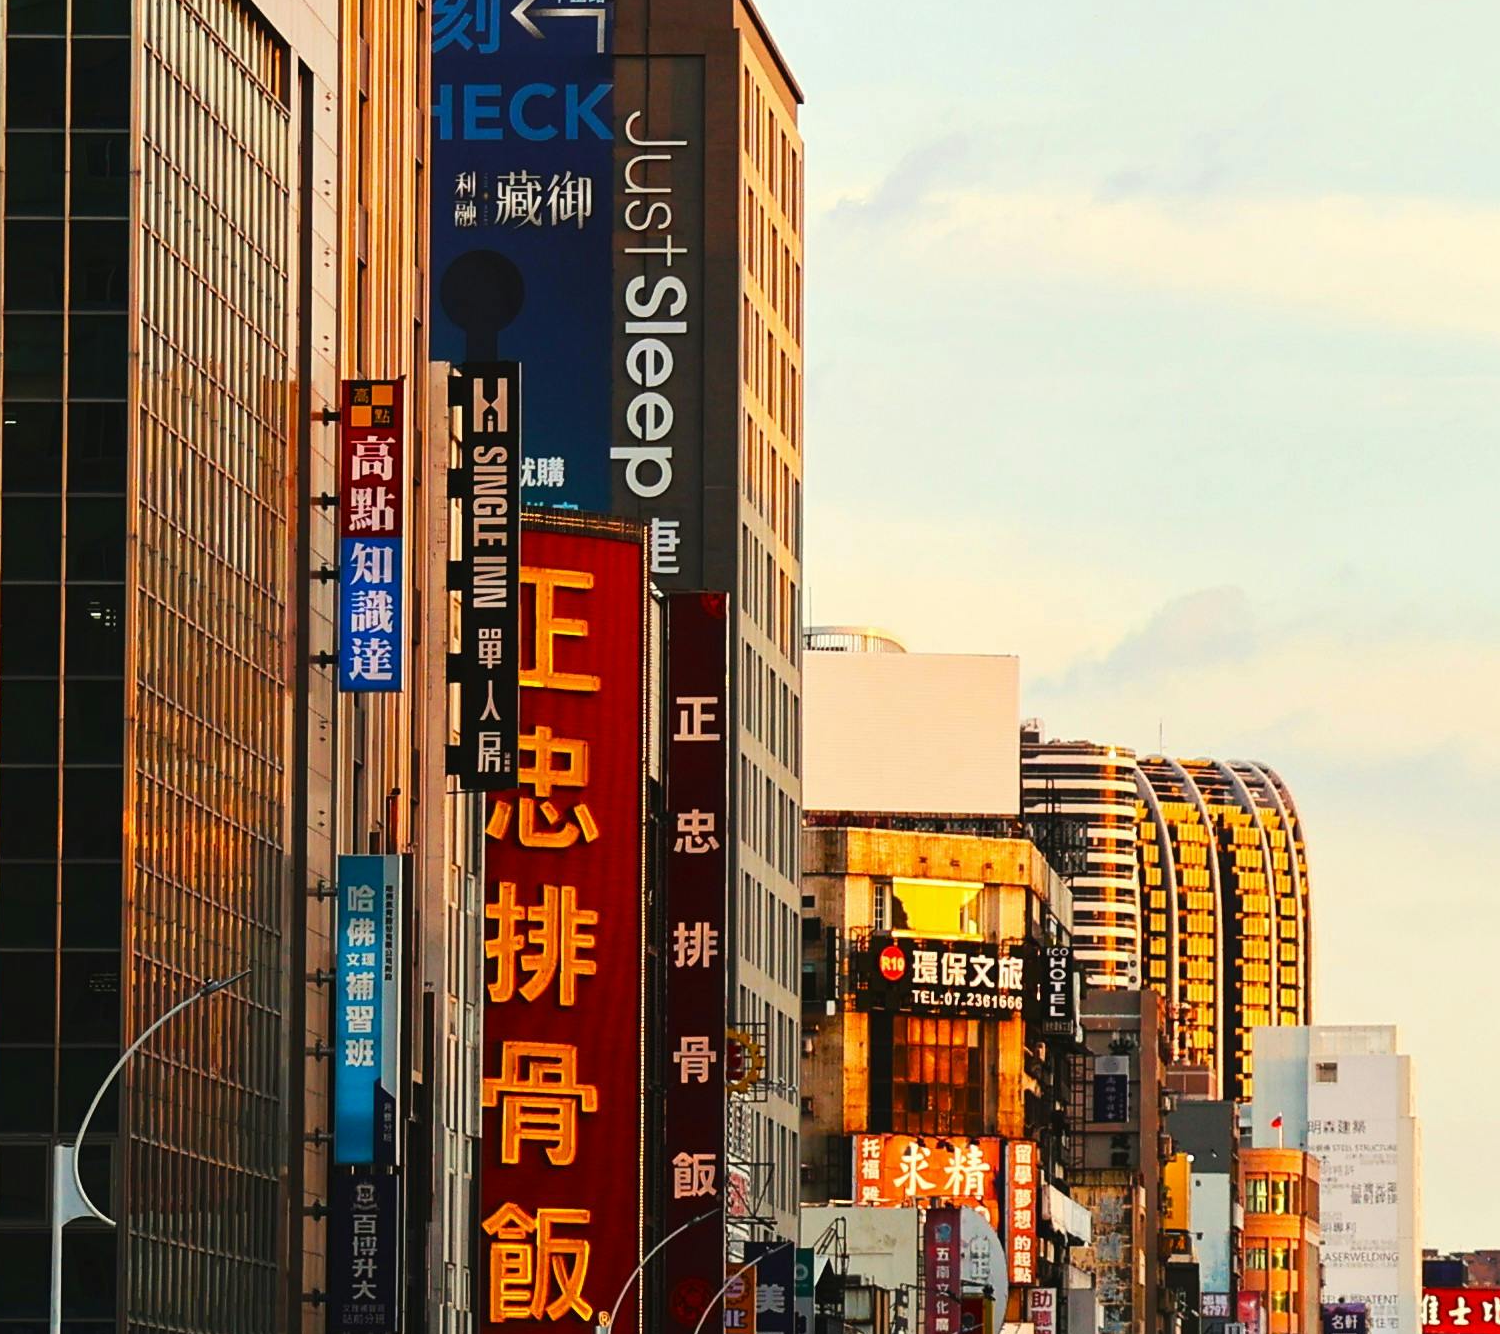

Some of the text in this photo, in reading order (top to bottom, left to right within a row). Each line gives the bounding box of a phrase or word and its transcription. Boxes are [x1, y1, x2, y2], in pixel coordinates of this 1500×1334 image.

[349, 435, 396, 532] 高點
[473, 446, 507, 609] SINGLE INN
[349, 541, 394, 682] 知識達
[476, 627, 503, 774] 單人房
[481, 566, 600, 1325] 正忠排骨飯
[671, 695, 722, 1199] 正忠排骨飯
[912, 949, 1023, 991] 環保文旅
[1049, 957, 1067, 1017] HOTEL
[861, 1138, 881, 1181] 托福
[892, 1143, 991, 1200] 求精
[352, 1214, 378, 1300] 百博升大
